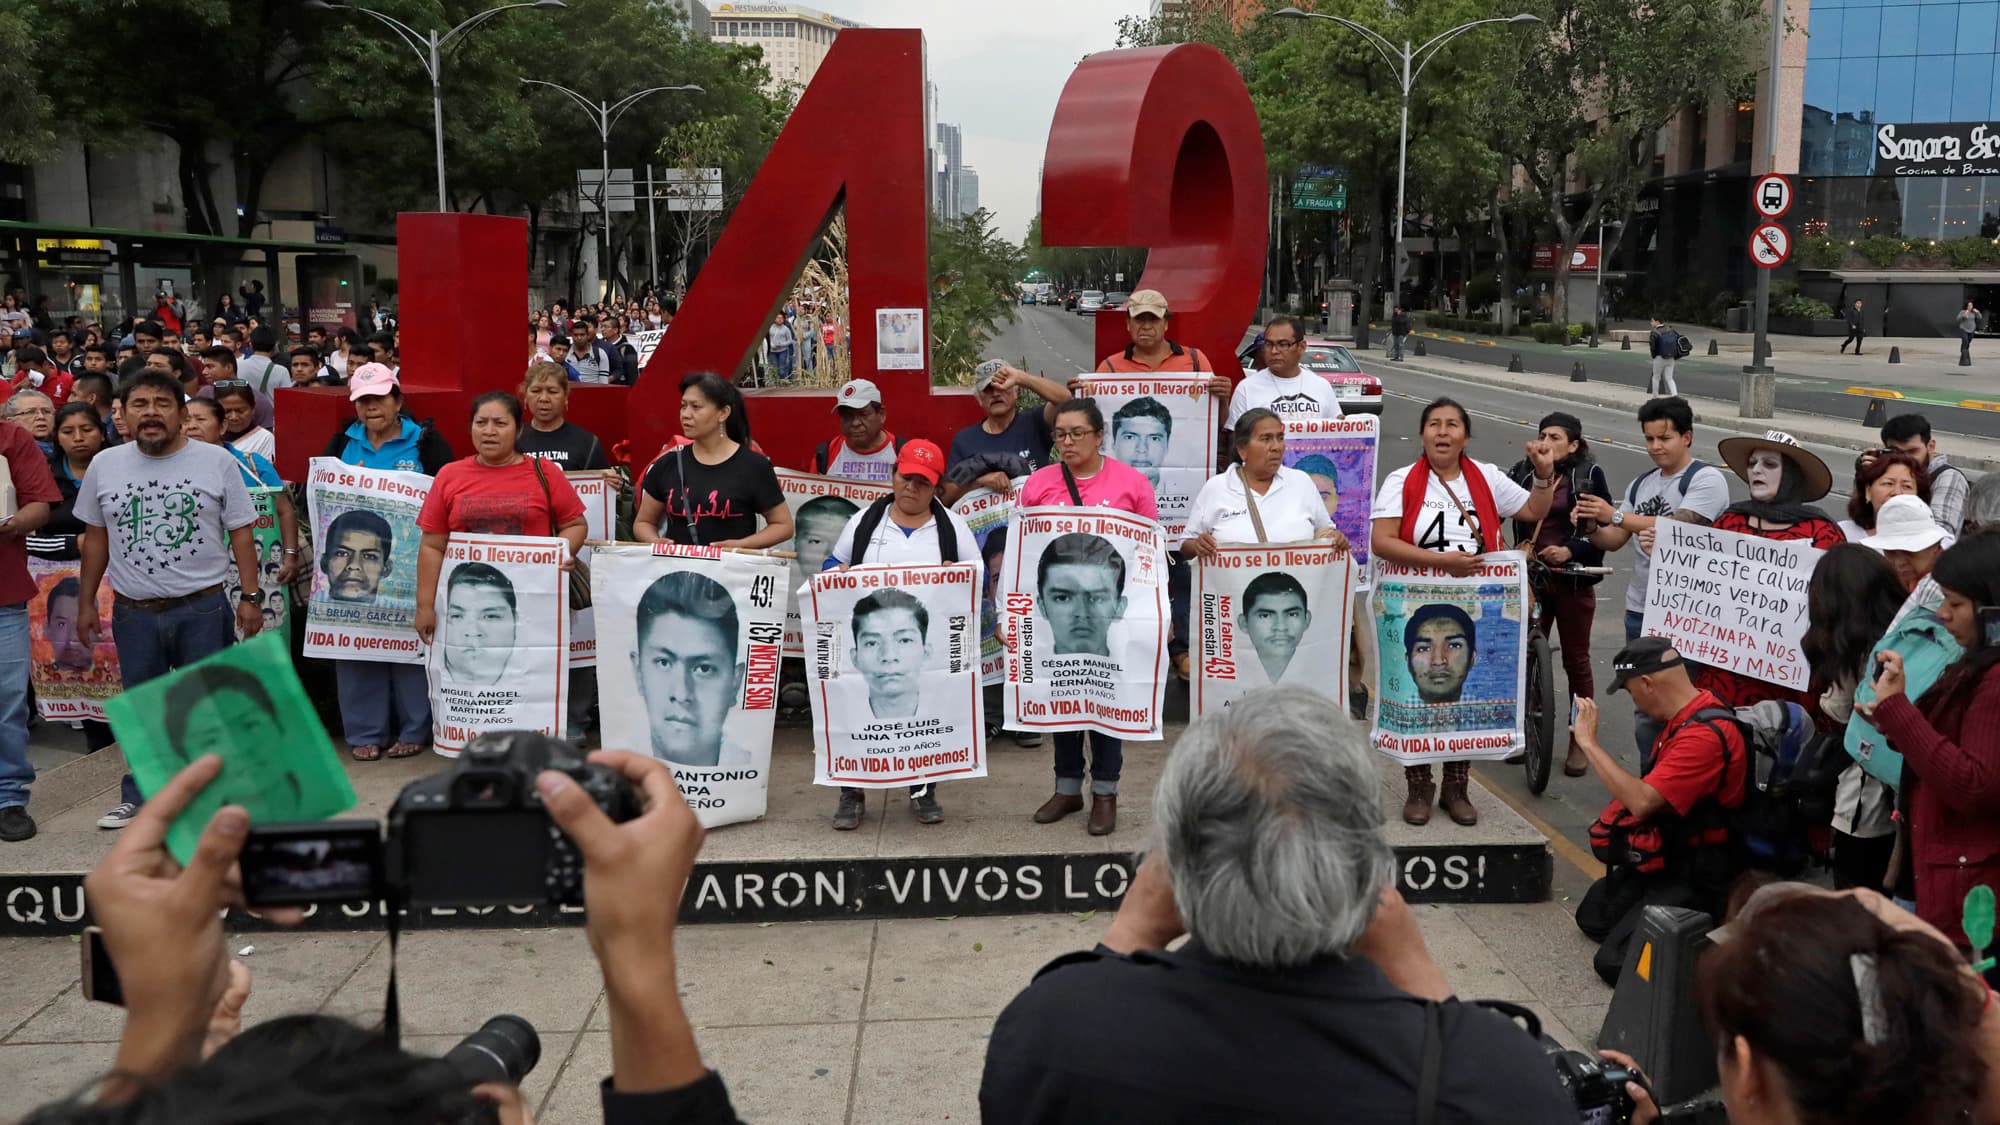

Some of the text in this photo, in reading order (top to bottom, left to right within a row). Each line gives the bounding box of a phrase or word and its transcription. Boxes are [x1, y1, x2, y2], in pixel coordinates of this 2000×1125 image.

[1878, 124, 1962, 162] Sonora
[1895, 165, 1937, 175] Cocina
[1942, 164, 1957, 175] de
[1305, 199, 1334, 207] FRAGUA
[1121, 385, 1134, 394] se
[1138, 382, 1151, 395] lo
[1153, 382, 1208, 396] llevaron!
[1289, 422, 1302, 433] se
[1306, 420, 1319, 433] lo
[338, 472, 356, 487] se
[358, 474, 374, 490] lo
[810, 484, 825, 496] se
[828, 483, 841, 498] lo
[972, 498, 987, 513] se
[989, 494, 1000, 507] lo
[1422, 500, 1445, 509] NOS
[1023, 519, 1153, 543] ¡Vivo se lo llevaron!
[454, 548, 465, 559] se
[469, 546, 482, 561] lo
[486, 547, 557, 565] llevaron!
[1671, 525, 1798, 570] Hasta Cuando
[1245, 554, 1262, 568] se
[1266, 551, 1281, 567] lo
[1706, 558, 1751, 581] este
[816, 569, 971, 593] ¡Vivo se lo llevaron!
[326, 608, 361, 619] BRUNO
[1219, 594, 1232, 619] Nos
[1202, 592, 1216, 657] Dónde están
[1734, 606, 1783, 638] Para
[306, 630, 421, 652] VIDA lo queremos!
[948, 615, 967, 674] NOS FALTAN 43
[1006, 615, 1018, 656] faltan
[1220, 620, 1234, 658] faltan
[1663, 610, 1797, 663] AYOTZINAPA NOS
[816, 638, 830, 665] FALTAN
[1022, 616, 1034, 684] Dónde están
[747, 644, 779, 687] FALTAN
[817, 665, 830, 680] NOS
[1008, 658, 1019, 683] Nos
[1083, 658, 1125, 672] MANUEL
[440, 687, 475, 698] MIGUEL
[744, 686, 775, 712] NOS
[1050, 689, 1081, 698] EDAD
[1083, 688, 1095, 697] 19
[46, 701, 78, 713] VIDA
[1023, 699, 1150, 724] ¡Con VIDA lo queremos!
[446, 715, 468, 724] EDAD
[483, 716, 514, 725] AÑOS
[907, 718, 941, 729] LUIS
[443, 724, 466, 742] VIDA
[850, 725, 955, 742] LUNA TORRES
[866, 740, 942, 755] EDAD 20 AÑOS
[1380, 733, 1399, 752] ¡Con
[1401, 736, 1431, 753] VIDA
[1433, 736, 1446, 752] lo
[834, 746, 970, 773] ¡Con VIDA lo queremos!
[674, 769, 759, 783] ANTONIO
[885, 863, 1043, 904] VIVOS
[1063, 862, 1129, 900] LO
